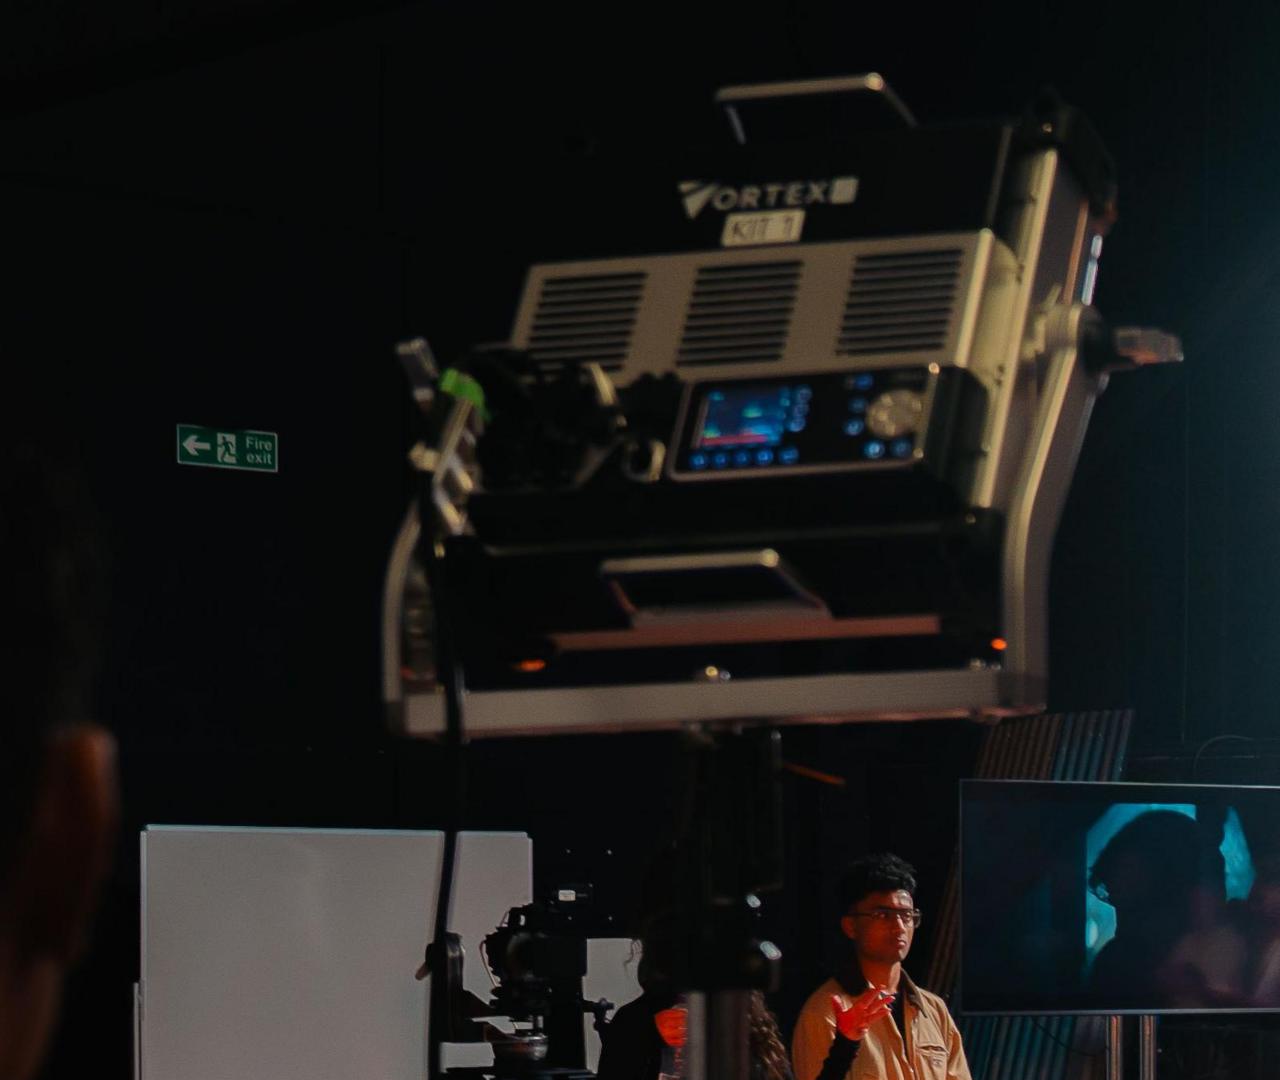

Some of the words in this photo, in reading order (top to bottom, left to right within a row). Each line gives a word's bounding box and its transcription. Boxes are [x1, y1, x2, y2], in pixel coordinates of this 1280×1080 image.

[677, 178, 830, 221] VORTEX
[245, 435, 273, 452] Fire
[245, 453, 273, 465] exit
